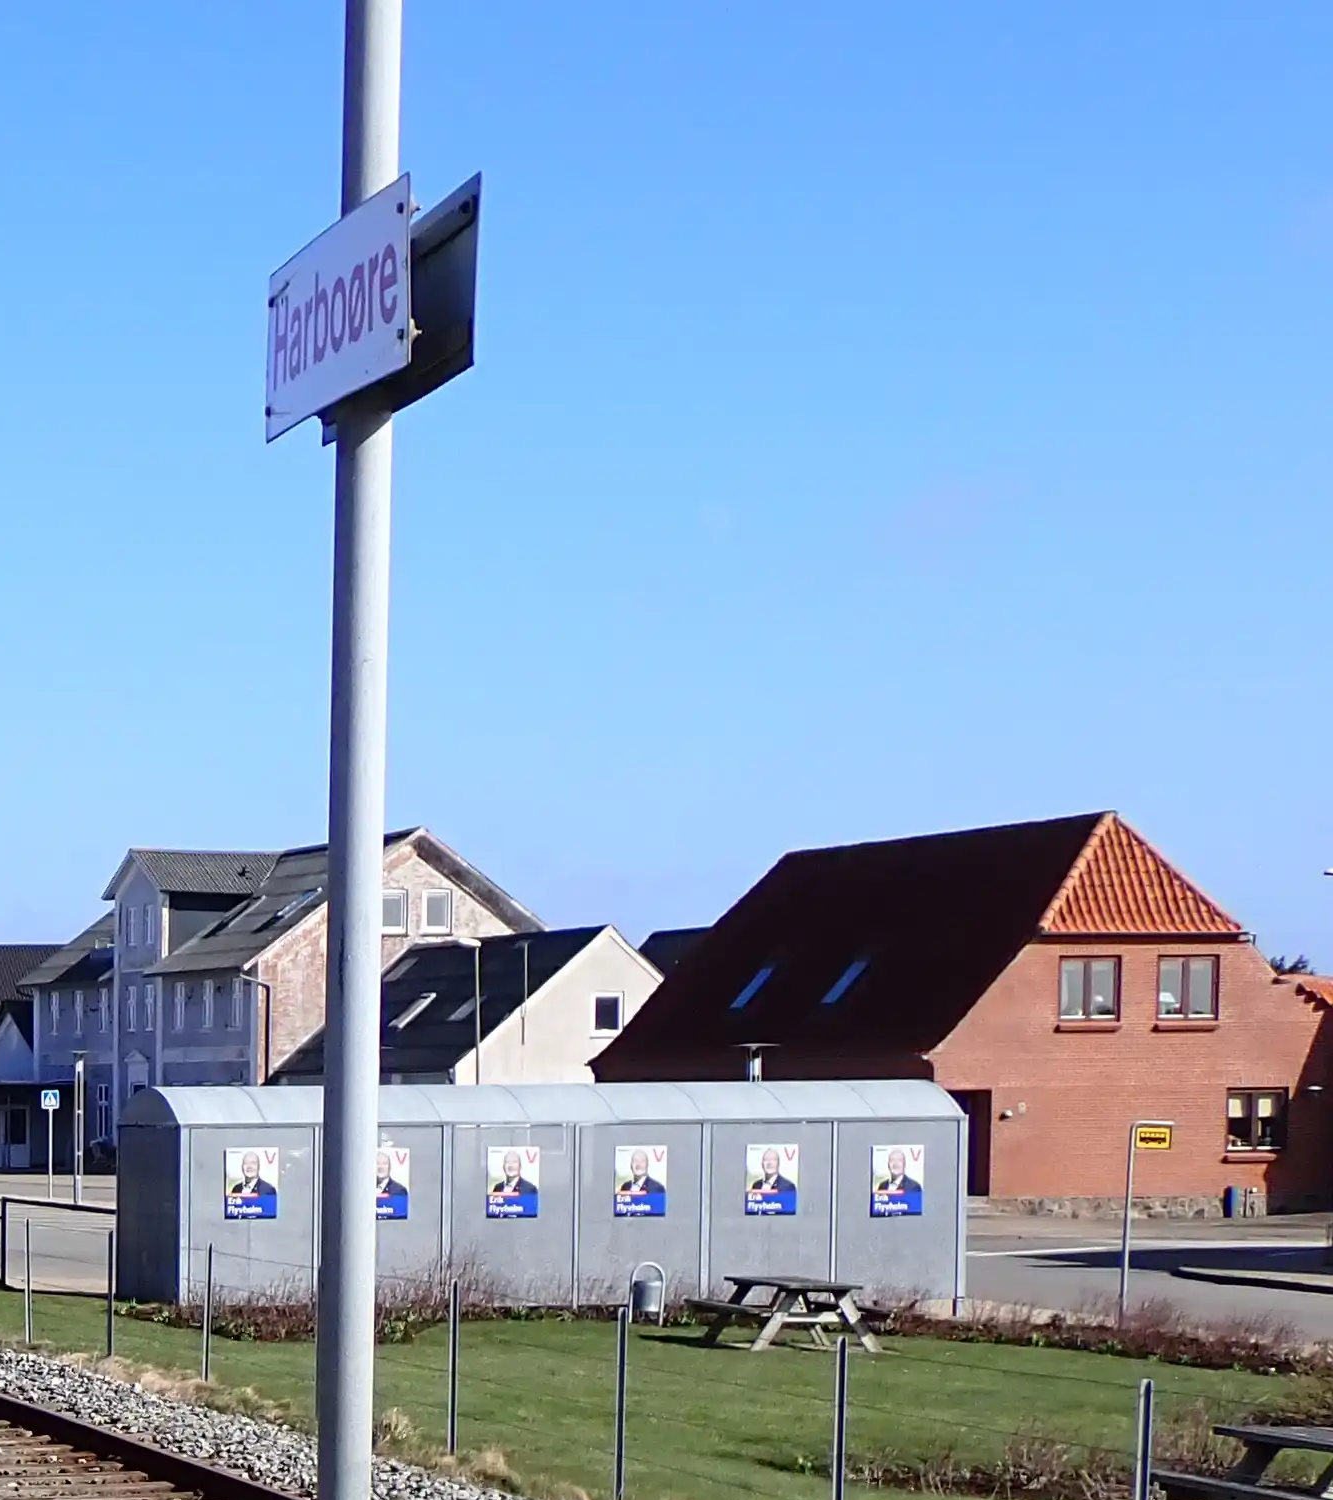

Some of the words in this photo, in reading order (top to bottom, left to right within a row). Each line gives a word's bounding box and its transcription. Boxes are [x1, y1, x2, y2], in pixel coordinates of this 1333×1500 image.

[273, 243, 399, 391] Harboøre
[264, 1149, 276, 1164] V
[395, 1150, 407, 1165] V
[525, 1149, 538, 1164] V
[653, 1148, 665, 1162] V
[784, 1147, 796, 1161] V
[910, 1147, 921, 1161] V
